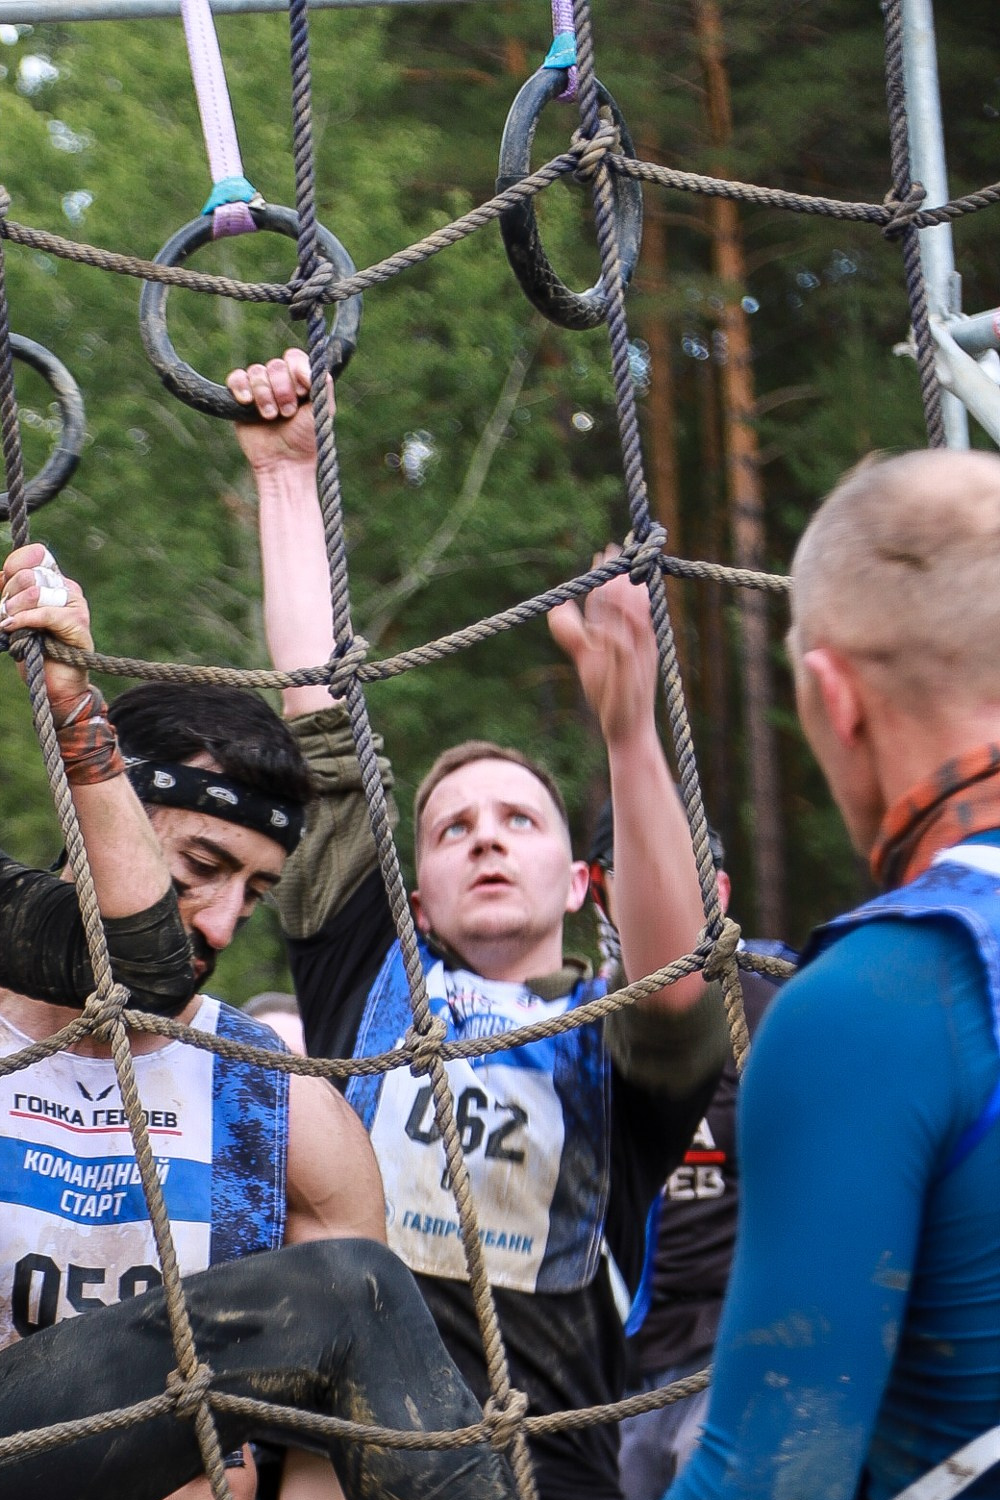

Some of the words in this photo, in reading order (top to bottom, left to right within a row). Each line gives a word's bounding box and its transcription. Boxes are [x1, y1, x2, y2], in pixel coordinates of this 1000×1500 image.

[14, 1093, 85, 1127] ГОНКА
[405, 1085, 529, 1165] 062
[60, 1189, 127, 1218] СТАРТ
[402, 1210, 534, 1255] ГАЗПРБАНК
